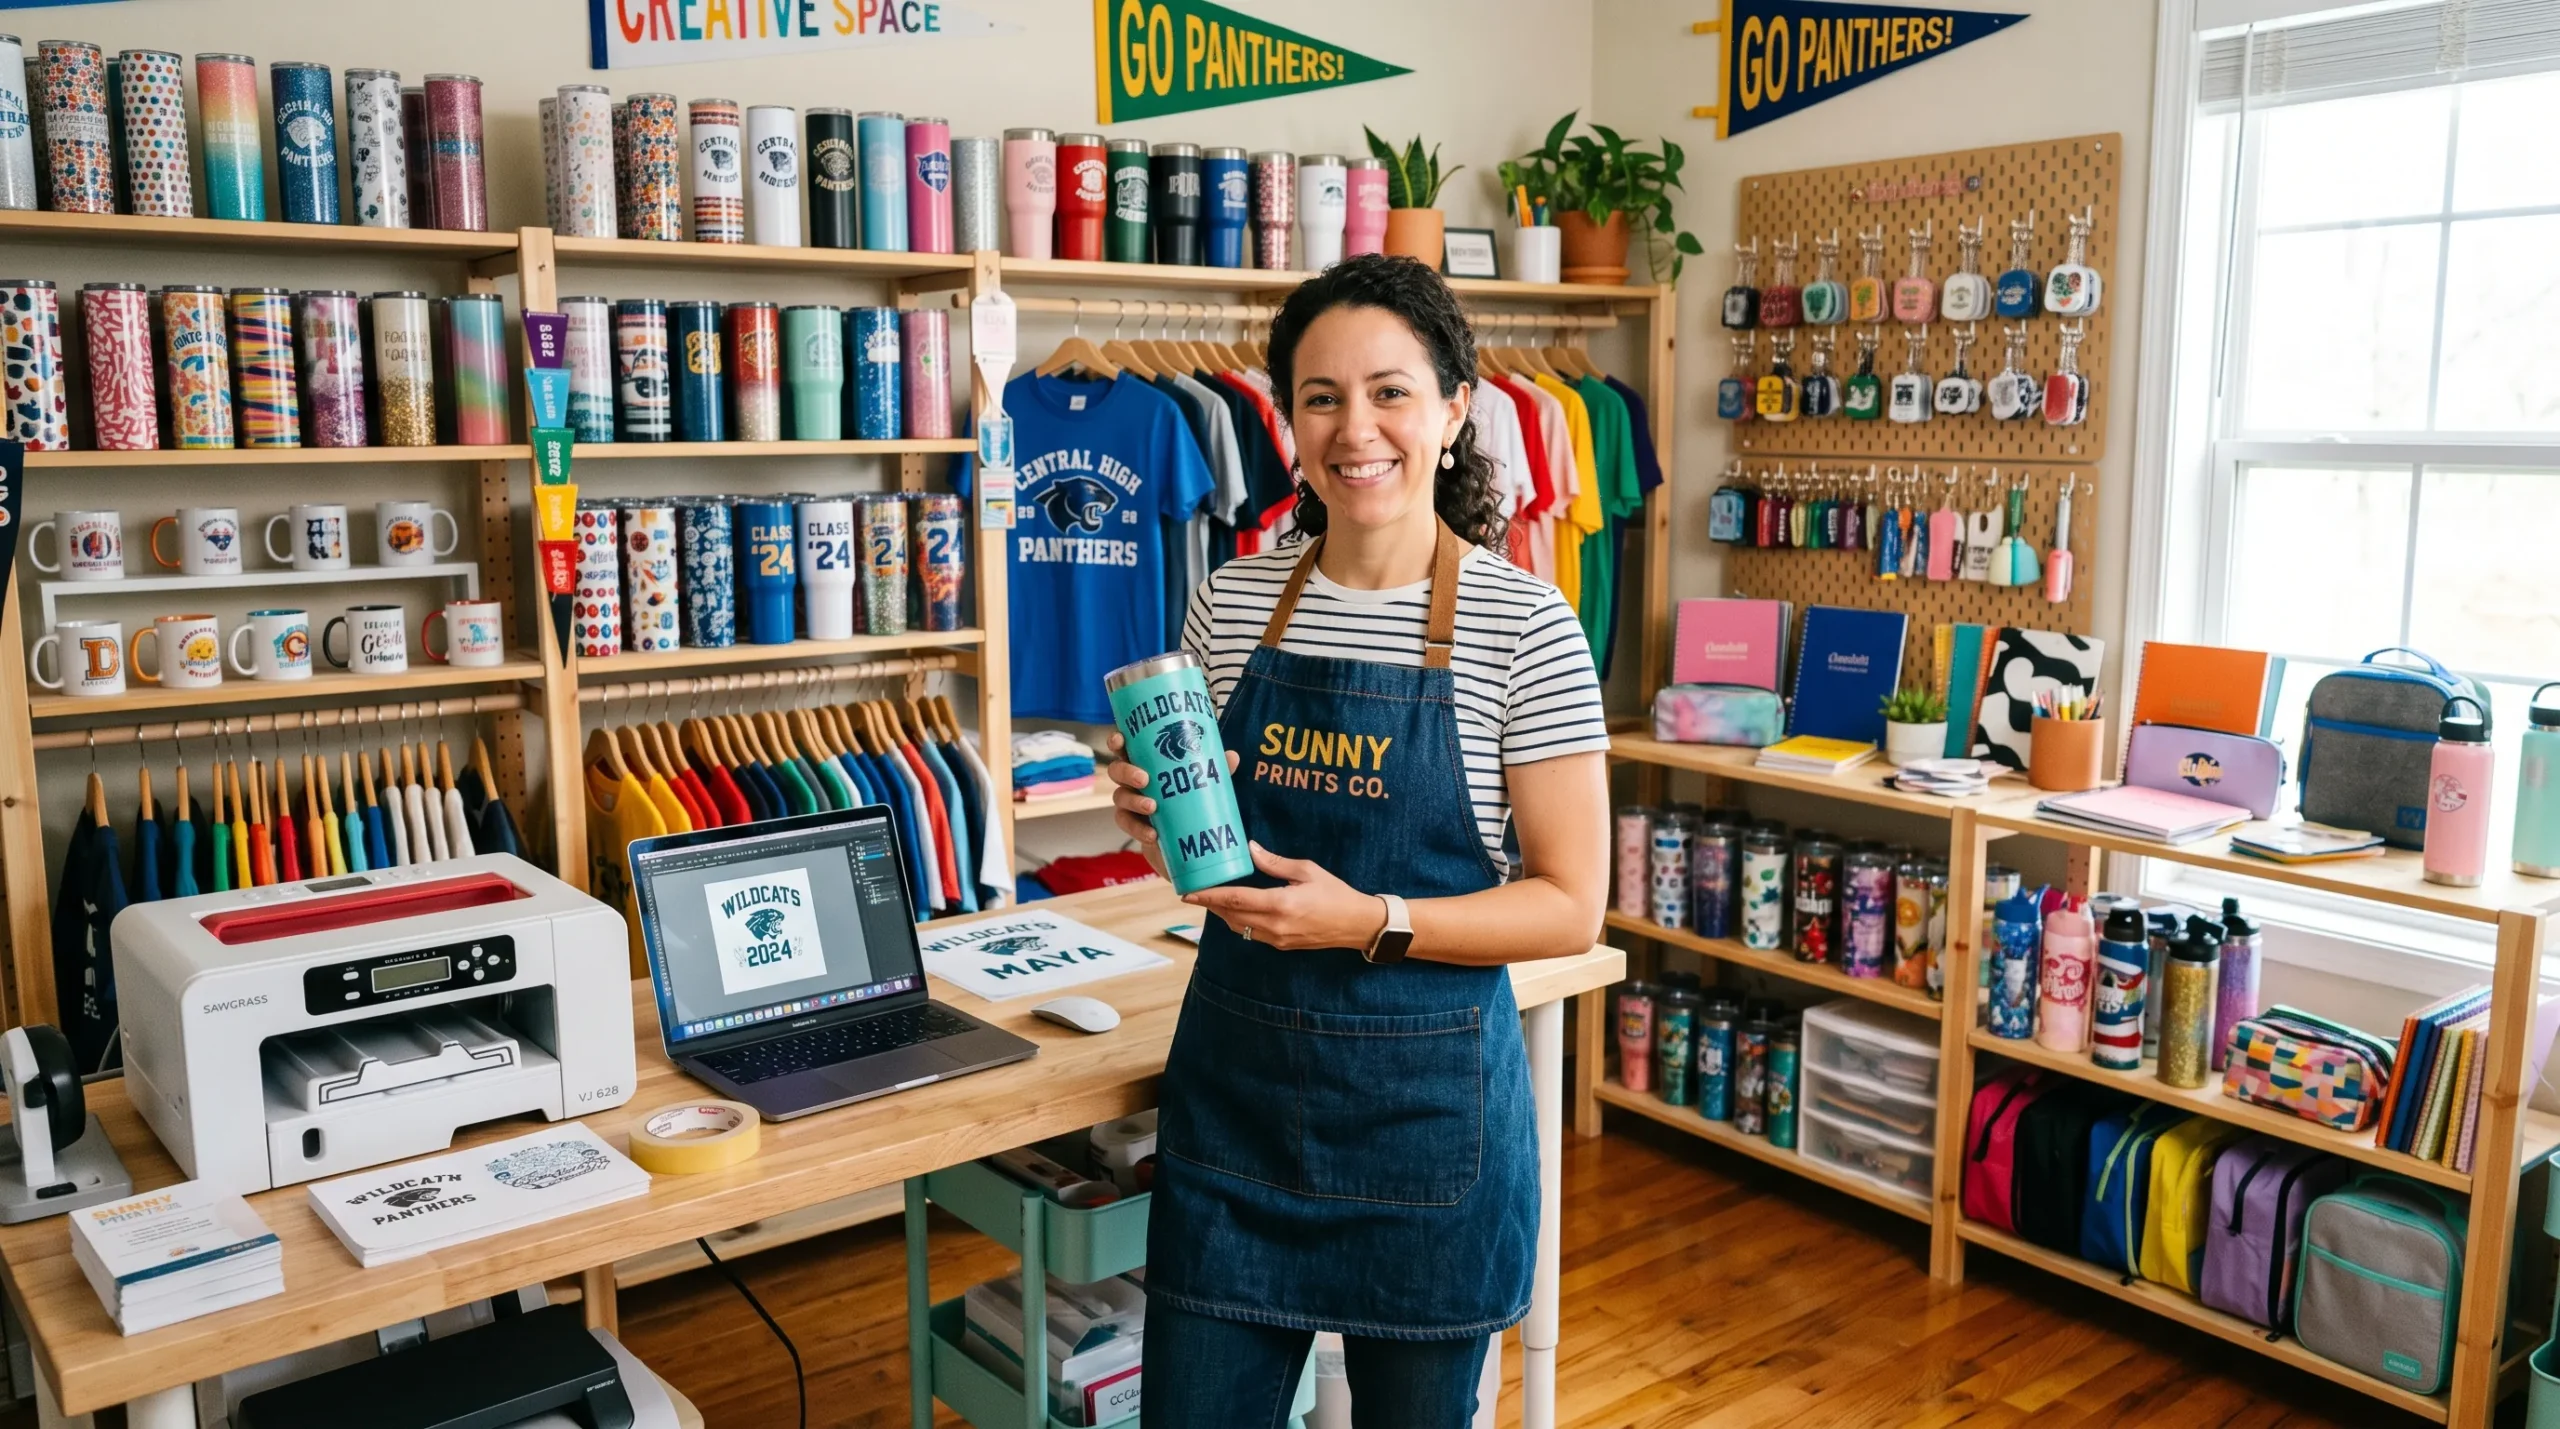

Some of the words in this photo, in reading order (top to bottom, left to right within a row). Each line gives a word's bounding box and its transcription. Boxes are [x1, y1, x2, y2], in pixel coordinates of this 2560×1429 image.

[833, 0, 941, 36] SPACE
[1119, 0, 1174, 98] GO
[1185, 13, 1345, 92] PANTHERS!
[1739, 15, 1790, 111] GO
[1797, 16, 1954, 93] PANTHERS!
[1015, 448, 1093, 491] CENTRAL
[1097, 454, 1142, 496] HIGH
[751, 525, 792, 542] CLASS
[808, 522, 849, 536] CLASS
[927, 528, 965, 564] 24
[874, 538, 906, 566] 24
[1018, 537, 1138, 567] PANTHERS
[80, 636, 120, 680] D
[1125, 690, 1214, 738] WILDCATS
[1259, 723, 1393, 771] SUNNY
[1157, 758, 1220, 799] 2024
[1254, 760, 1339, 794] PRINTS
[1348, 775, 1390, 799] CO.
[1178, 823, 1239, 862] MAYA
[721, 885, 801, 919] WILDCATS
[746, 939, 792, 967] 2024
[982, 946, 1115, 980] MAYA
[203, 994, 268, 1014] SAWGRASS
[578, 1091, 593, 1102] VJ
[596, 1085, 619, 1099] 628
[372, 1194, 477, 1225] PANTHERS
